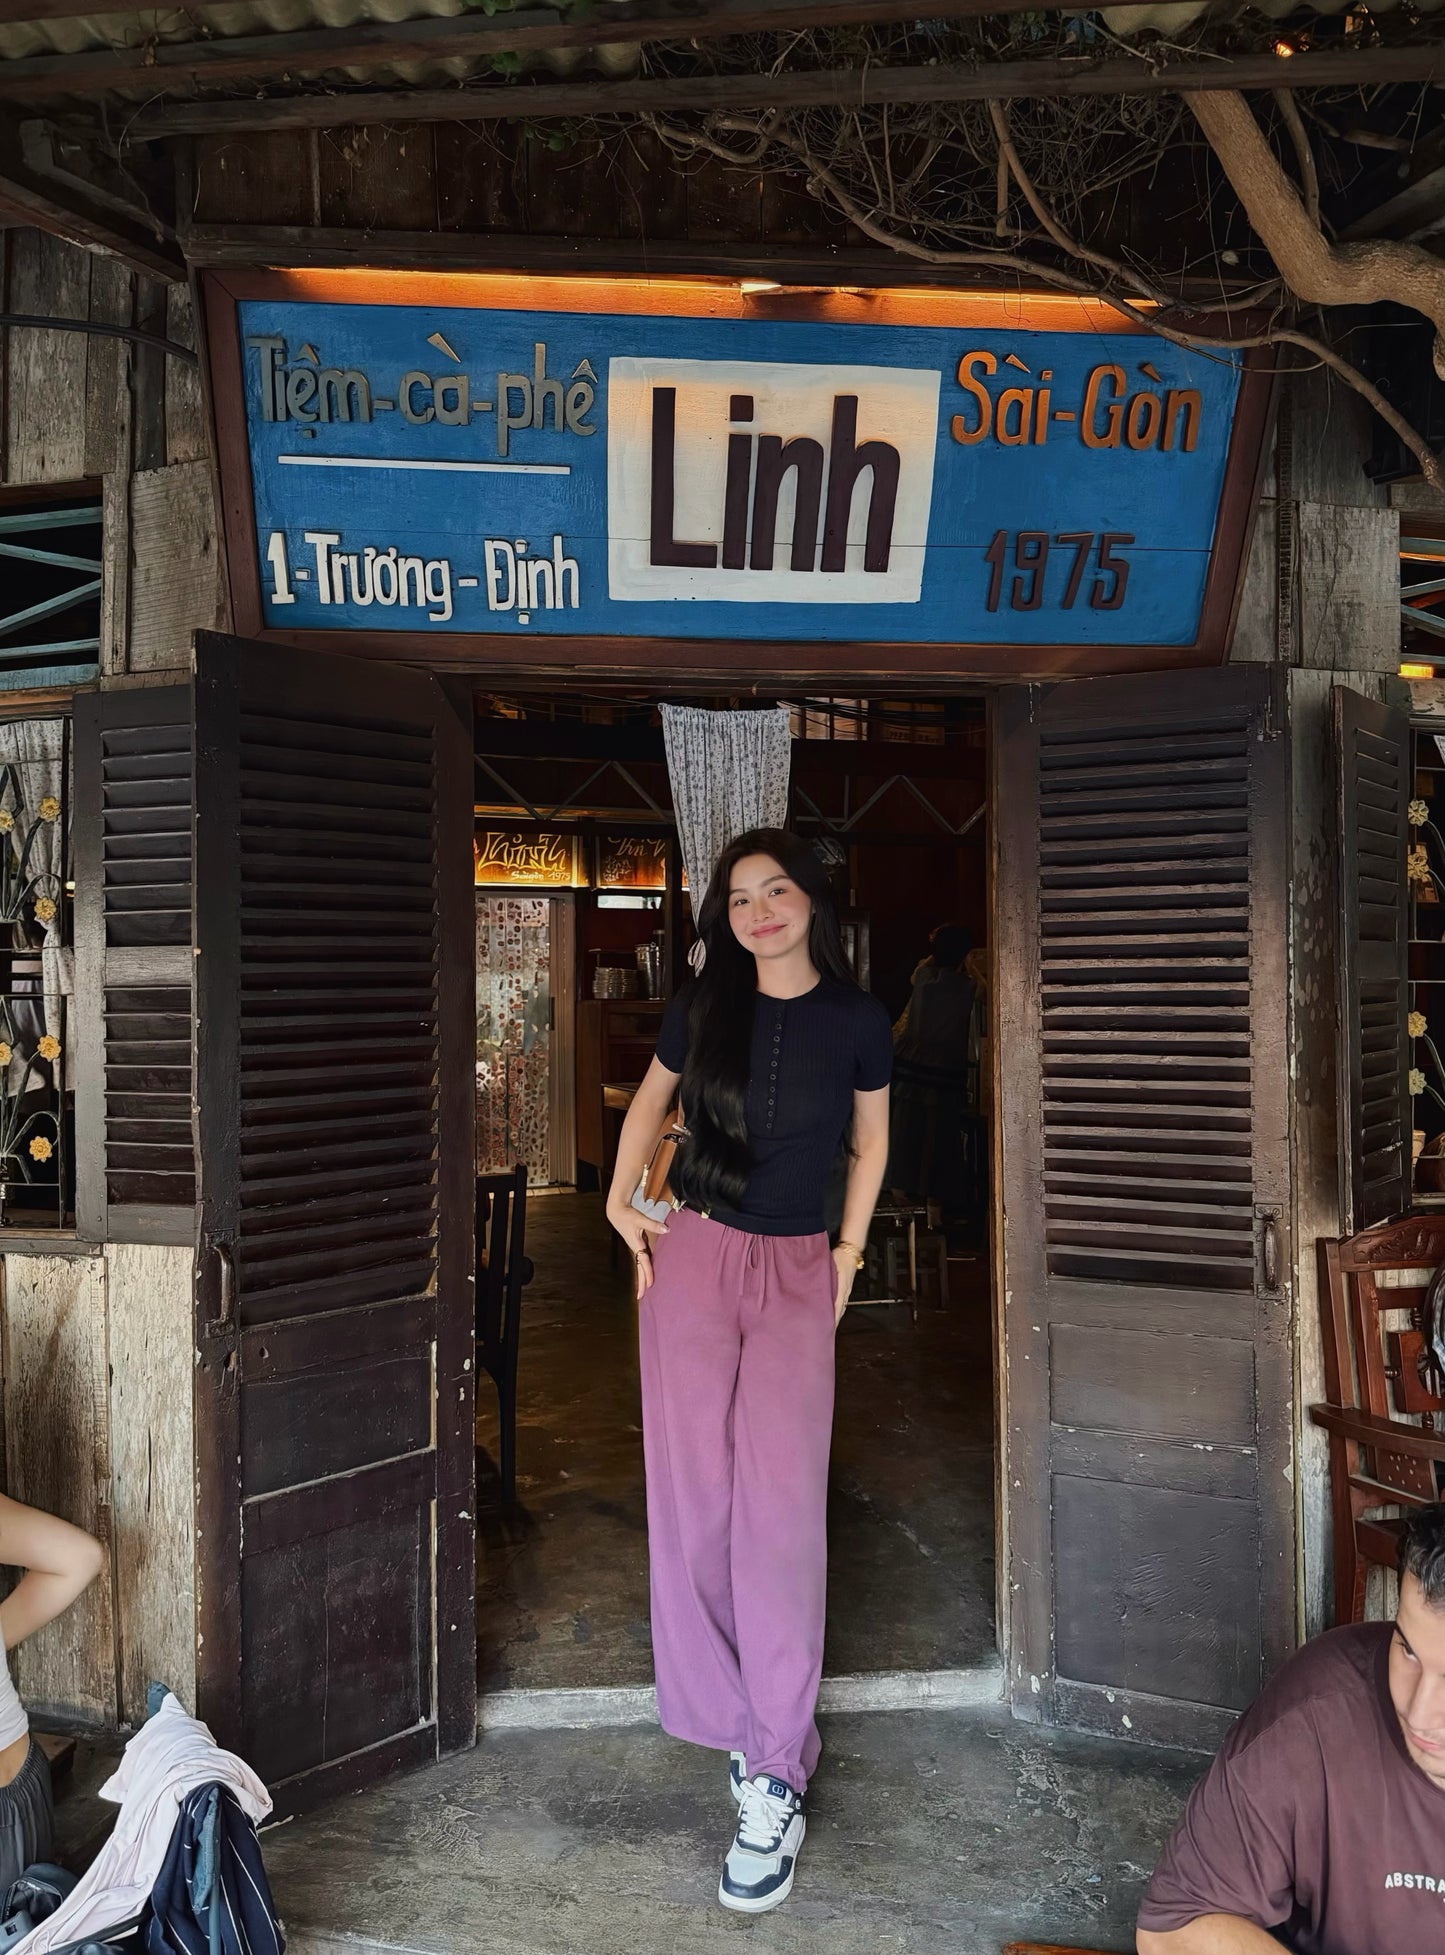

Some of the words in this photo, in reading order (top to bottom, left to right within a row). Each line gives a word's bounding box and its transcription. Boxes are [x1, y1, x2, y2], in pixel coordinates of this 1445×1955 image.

[247, 332, 597, 457] Tiệm-cà-phê
[951, 351, 1202, 453] Sài-Gòn
[650, 387, 900, 573] Linh
[985, 530, 1135, 612] 1975
[548, 872, 571, 881] 1975
